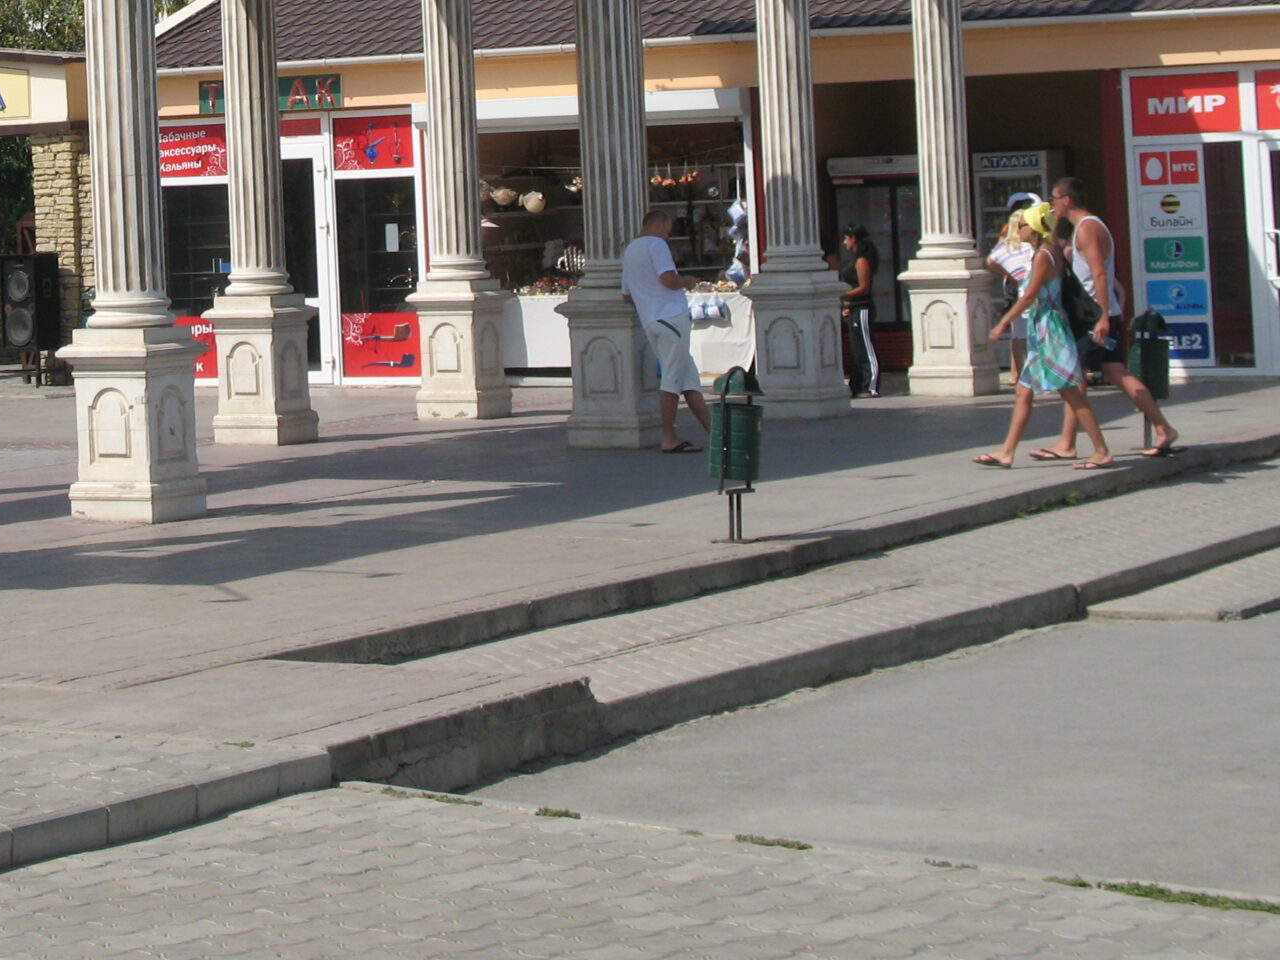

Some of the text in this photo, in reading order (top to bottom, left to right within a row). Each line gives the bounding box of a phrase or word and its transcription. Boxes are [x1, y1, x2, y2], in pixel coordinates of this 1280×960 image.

[1147, 94, 1226, 115] МИР
[981, 155, 1038, 168] АТЛАНТ
[1172, 163, 1196, 172] МТС
